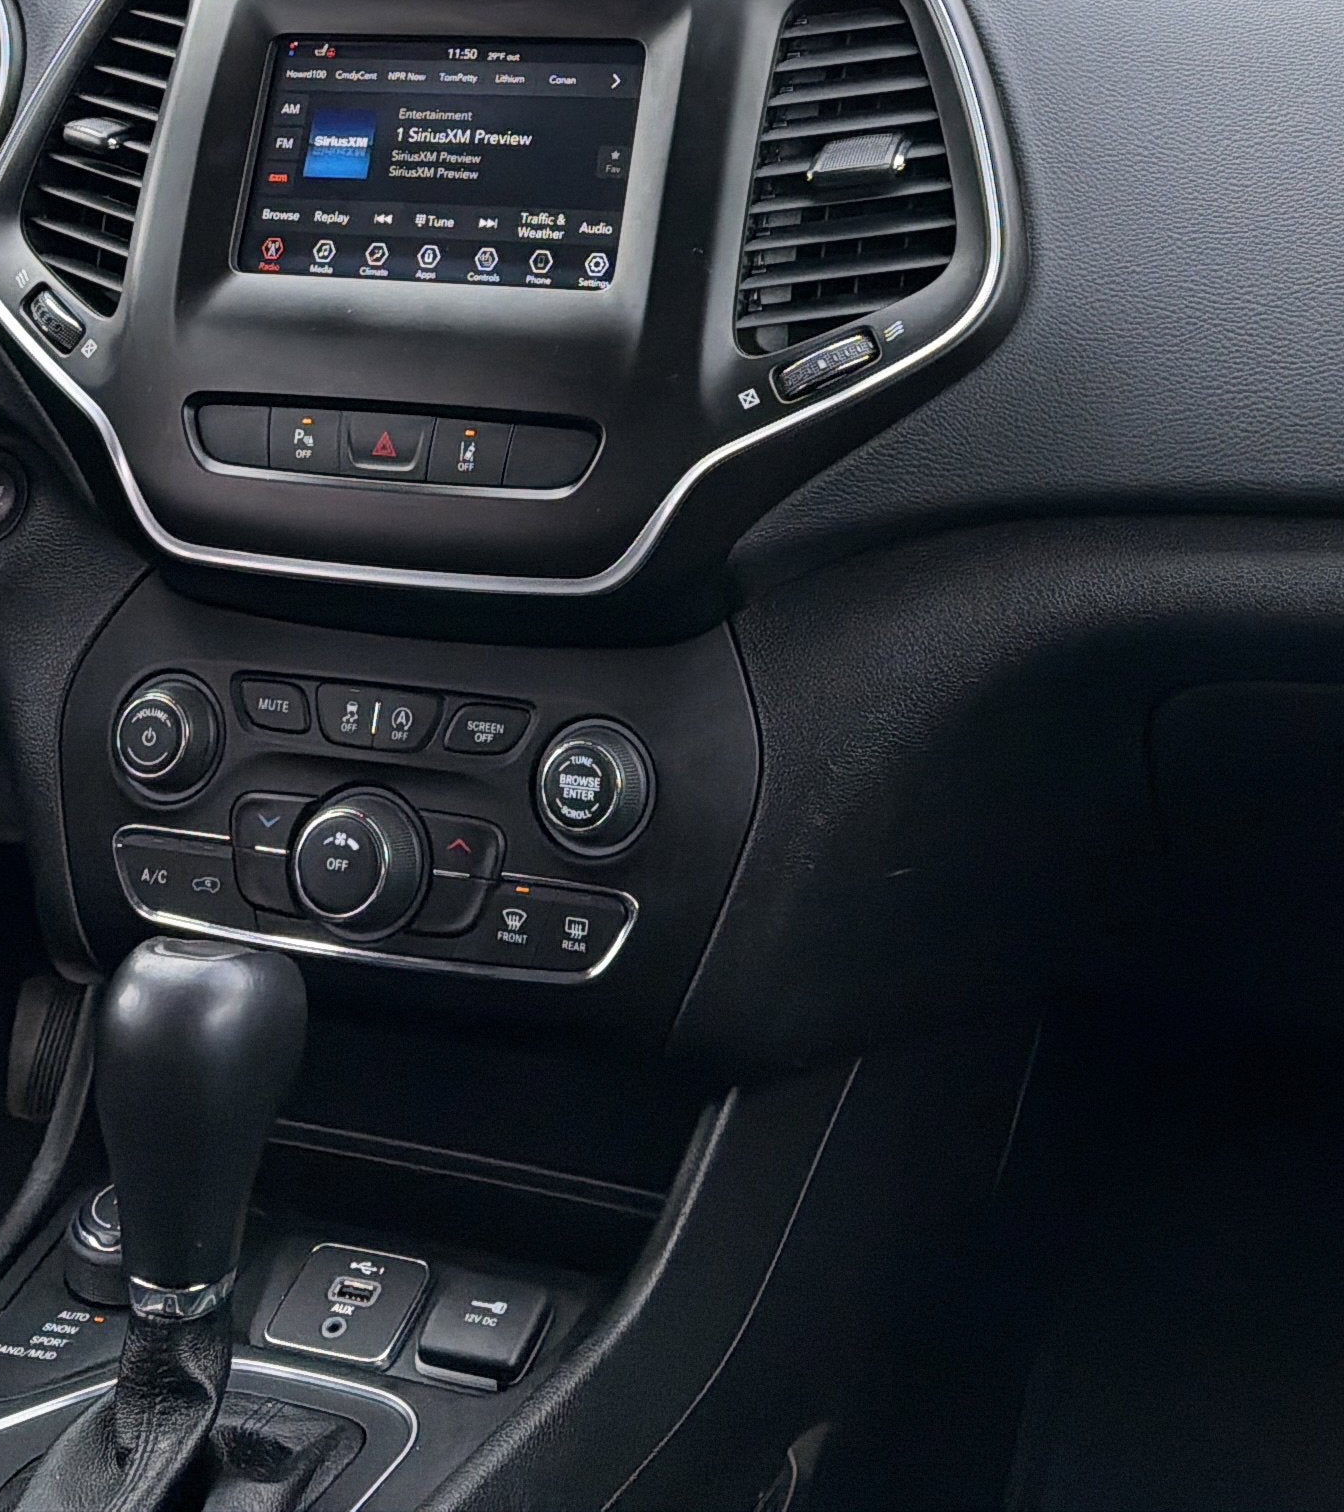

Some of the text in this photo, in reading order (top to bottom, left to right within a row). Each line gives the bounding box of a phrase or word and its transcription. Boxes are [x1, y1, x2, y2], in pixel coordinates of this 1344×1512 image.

[448, 48, 478, 60] 11:50
[281, 103, 300, 115] AM
[399, 108, 473, 121] Entertainment
[275, 137, 294, 149] FM
[408, 128, 470, 144] SiriusXM
[474, 129, 533, 146] Preview
[392, 150, 482, 165] SiriusXM Preview
[388, 166, 479, 180] SiriusXM Preview
[606, 164, 621, 174] Fav
[262, 209, 300, 222] Browse
[314, 211, 350, 225] Replay
[427, 216, 454, 228] Tune
[521, 212, 567, 226] Traffic &
[518, 227, 565, 240] Weather
[579, 221, 613, 235] Audio
[258, 262, 280, 271] Radio
[309, 264, 333, 274] Media
[359, 266, 388, 277] Climate
[415, 270, 436, 280] Apps
[467, 272, 500, 283] Controls
[526, 275, 551, 285] Phone
[296, 449, 312, 459] OFF
[457, 462, 475, 472] OFF
[258, 697, 289, 713] MUTE
[136, 707, 168, 723] VOLUME
[340, 722, 358, 733] OFF
[467, 720, 505, 734] SCREEN
[391, 731, 409, 741] OFF
[474, 733, 495, 744] OFF
[571, 755, 593, 767] TUNE
[559, 773, 601, 788] BROWSE
[563, 788, 595, 801] ENTER
[560, 805, 592, 820] SCROLL
[326, 857, 349, 872] OFF
[140, 867, 168, 885] A/C
[497, 930, 528, 945] FRONT
[561, 939, 587, 953] REAR
[57, 1310, 91, 1322] AUTO
[330, 1303, 355, 1316] AUX
[464, 1312, 498, 1327] 12V DC
[42, 1322, 80, 1334] SNOW
[29, 1335, 69, 1347] SPORT
